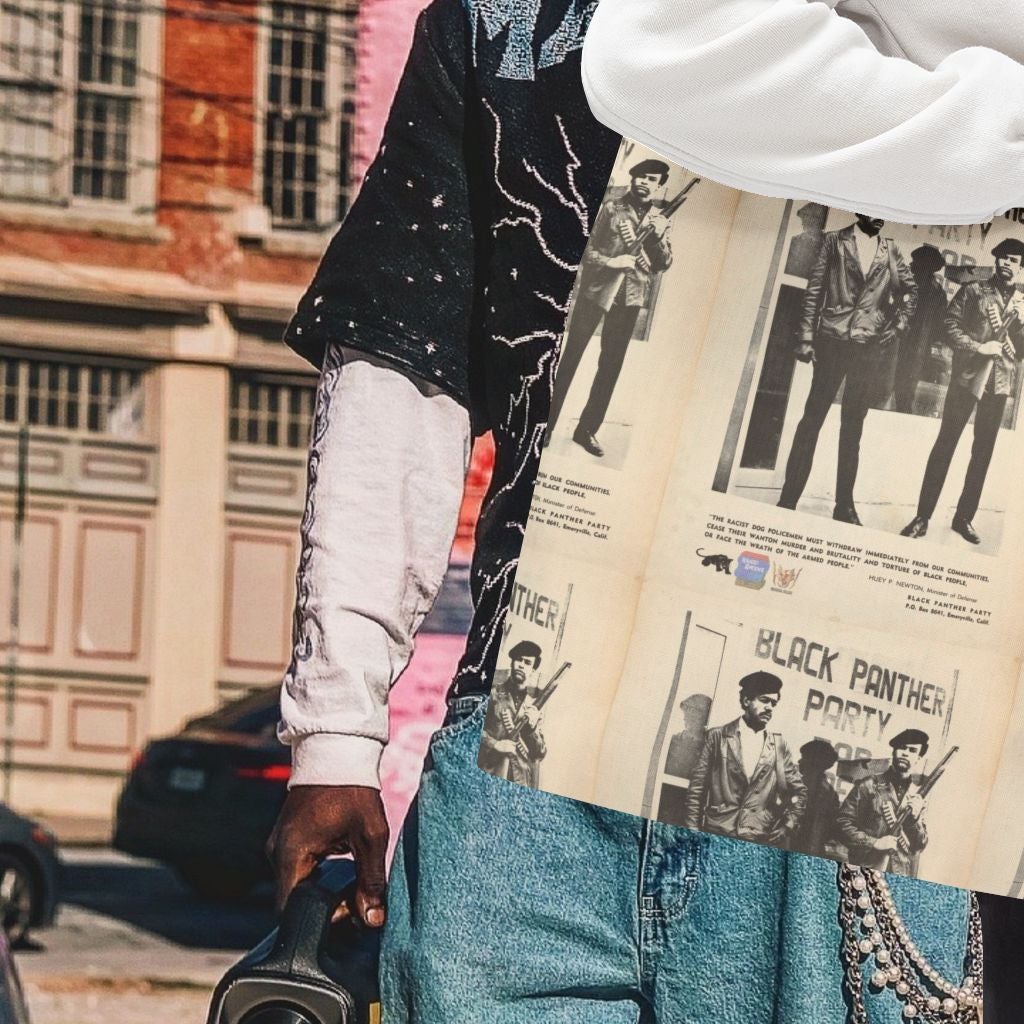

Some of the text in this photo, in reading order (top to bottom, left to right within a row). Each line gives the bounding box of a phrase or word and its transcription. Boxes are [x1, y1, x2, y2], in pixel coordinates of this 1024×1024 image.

[542, 482, 560, 492] BLACK
[550, 474, 562, 483] OUR
[530, 506, 612, 532] LACK PANTHER PARTY
[706, 522, 725, 533] CEASE
[728, 527, 747, 537] THEIR
[750, 533, 778, 545] WANTON
[781, 540, 807, 551] MURDER
[809, 546, 824, 554] AND
[826, 550, 862, 563] BRUTALITY
[864, 558, 879, 567] AND
[882, 562, 910, 574] TORTURE
[912, 568, 921, 576] OF
[924, 571, 943, 581] BLACK
[716, 534, 732, 543] FACE
[735, 538, 747, 547] THE
[750, 541, 773, 552] WRATH
[775, 547, 784, 555] OF
[787, 550, 800, 558] THE
[802, 553, 825, 563] ARMED
[727, 518, 749, 529] RACIST
[752, 524, 765, 532] DOG
[768, 528, 803, 541] POLICEMEN
[806, 536, 824, 545] MUST
[826, 541, 863, 553] WITHDRAW
[865, 550, 910, 564] IMMEDIATELY
[912, 559, 930, 569] FROM
[931, 564, 945, 572] OUR
[868, 575, 887, 584] HUEY
[907, 594, 993, 617] BLACK PANTHER PARTY
[755, 628, 947, 717] BLACK PANTHER
[803, 688, 893, 742] PARTY
